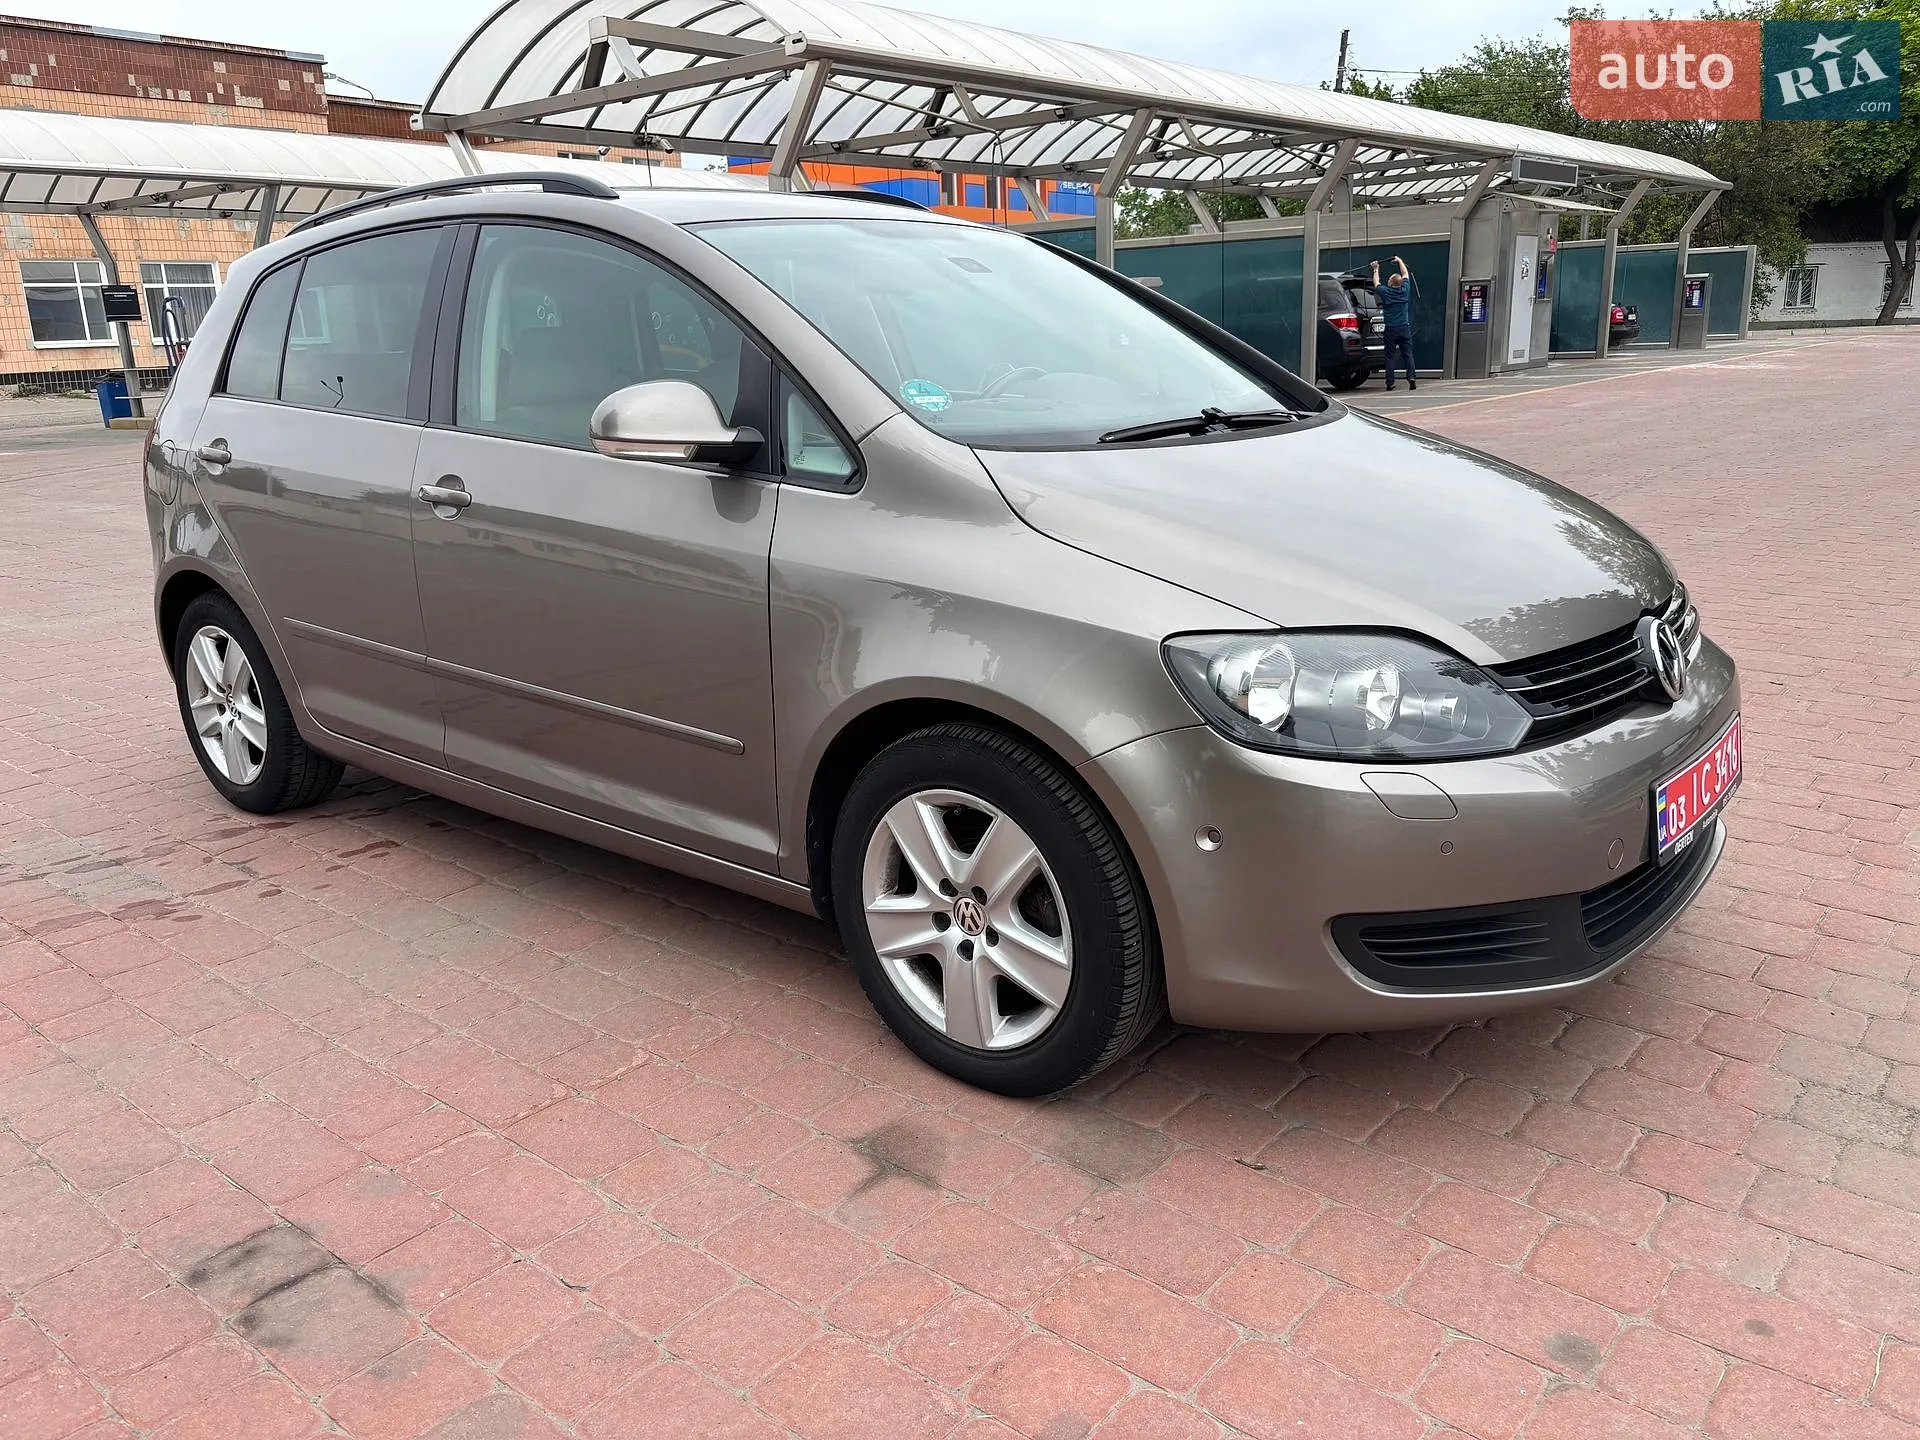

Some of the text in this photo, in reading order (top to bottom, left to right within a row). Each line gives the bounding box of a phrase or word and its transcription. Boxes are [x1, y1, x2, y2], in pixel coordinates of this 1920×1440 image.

[1668, 794, 1687, 837] 03
[1713, 728, 1738, 795] 3416
[1659, 827, 1668, 843] UA
